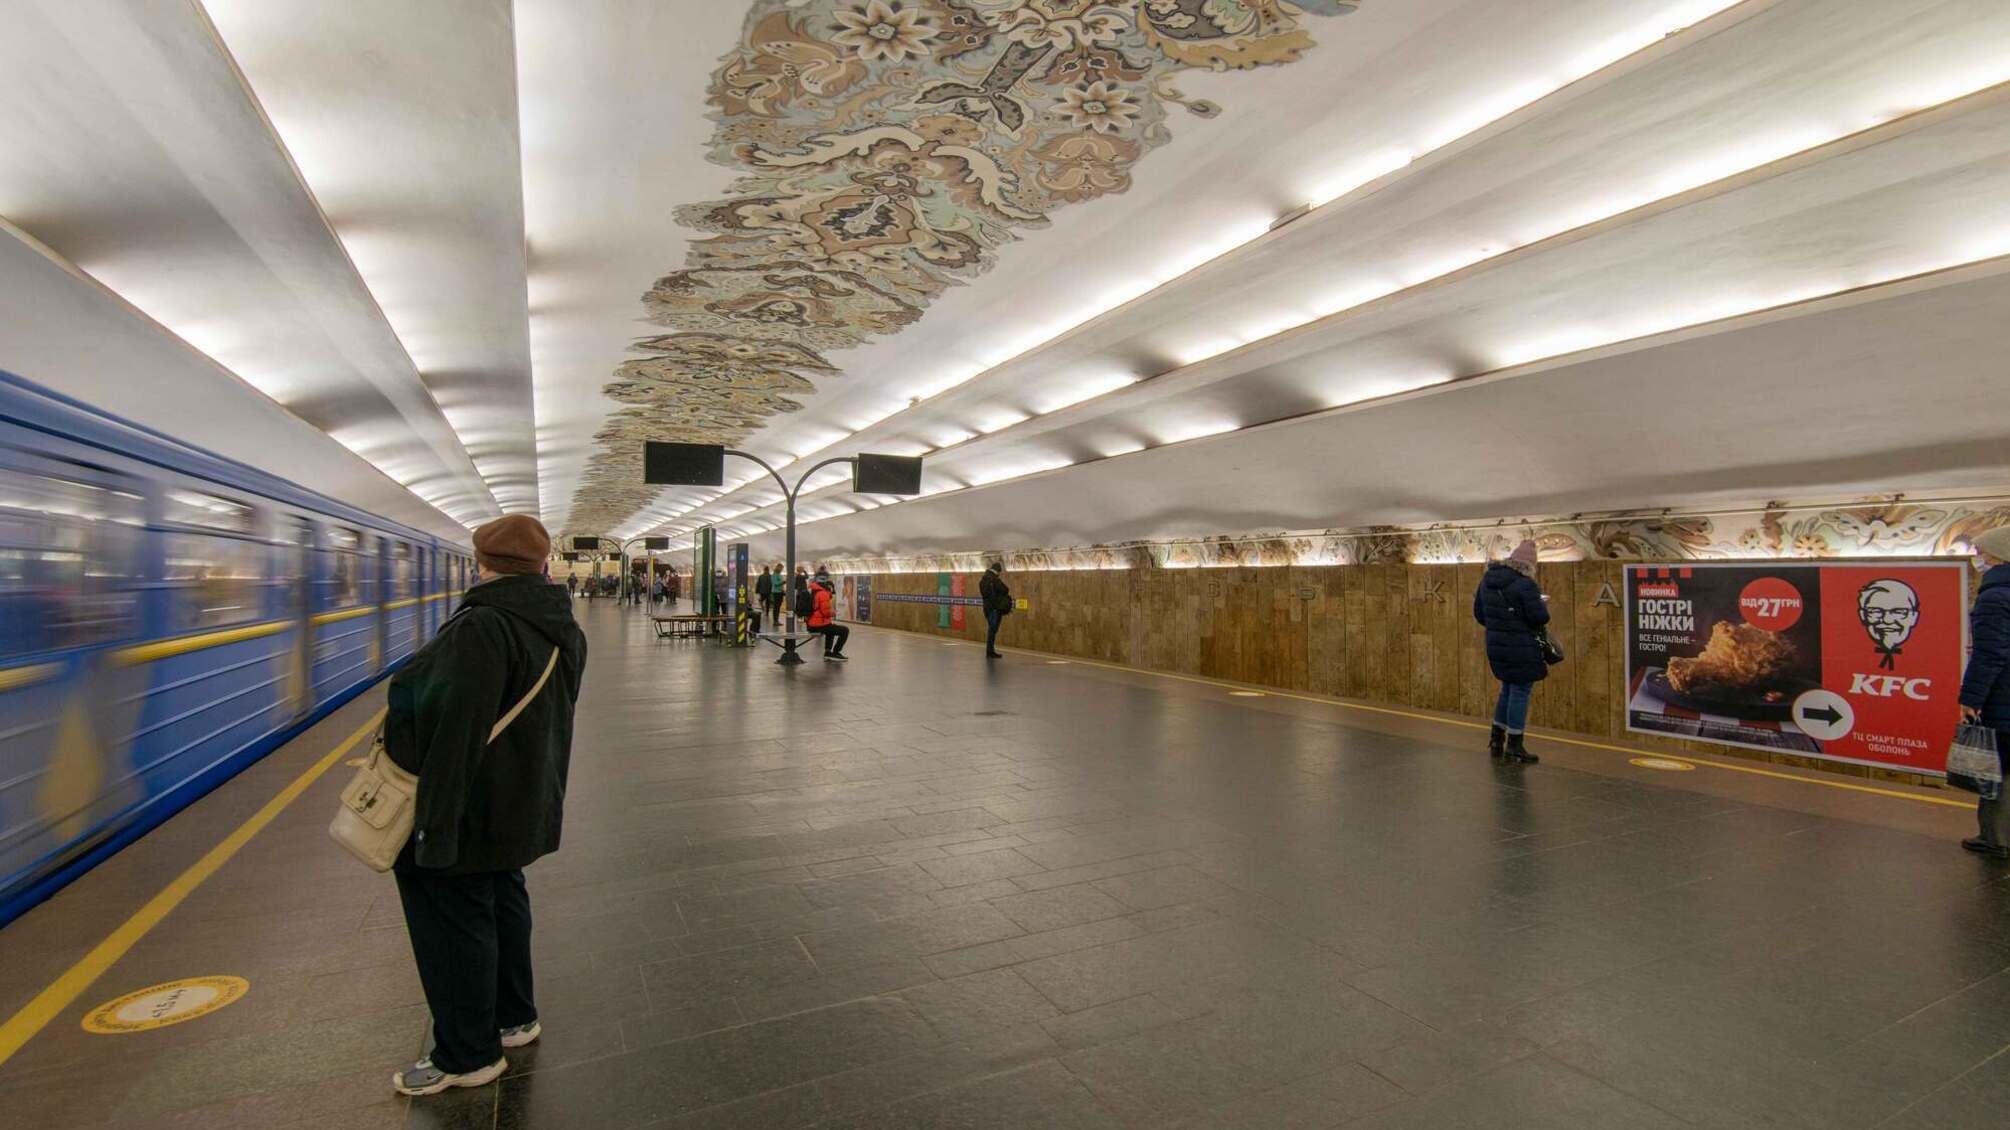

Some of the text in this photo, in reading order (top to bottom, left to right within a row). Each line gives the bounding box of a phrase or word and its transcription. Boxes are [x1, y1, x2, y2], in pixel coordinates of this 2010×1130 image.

[1638, 599, 1693, 616] ГОСТРІ
[1757, 598, 1781, 617] 27
[1781, 598, 1800, 608] ГРН
[1638, 614, 1695, 632] НІЖКИ
[1848, 672, 1932, 701] KFC
[1865, 734, 1895, 745] СМАРТ
[1897, 737, 1928, 749] ПЛАЗА
